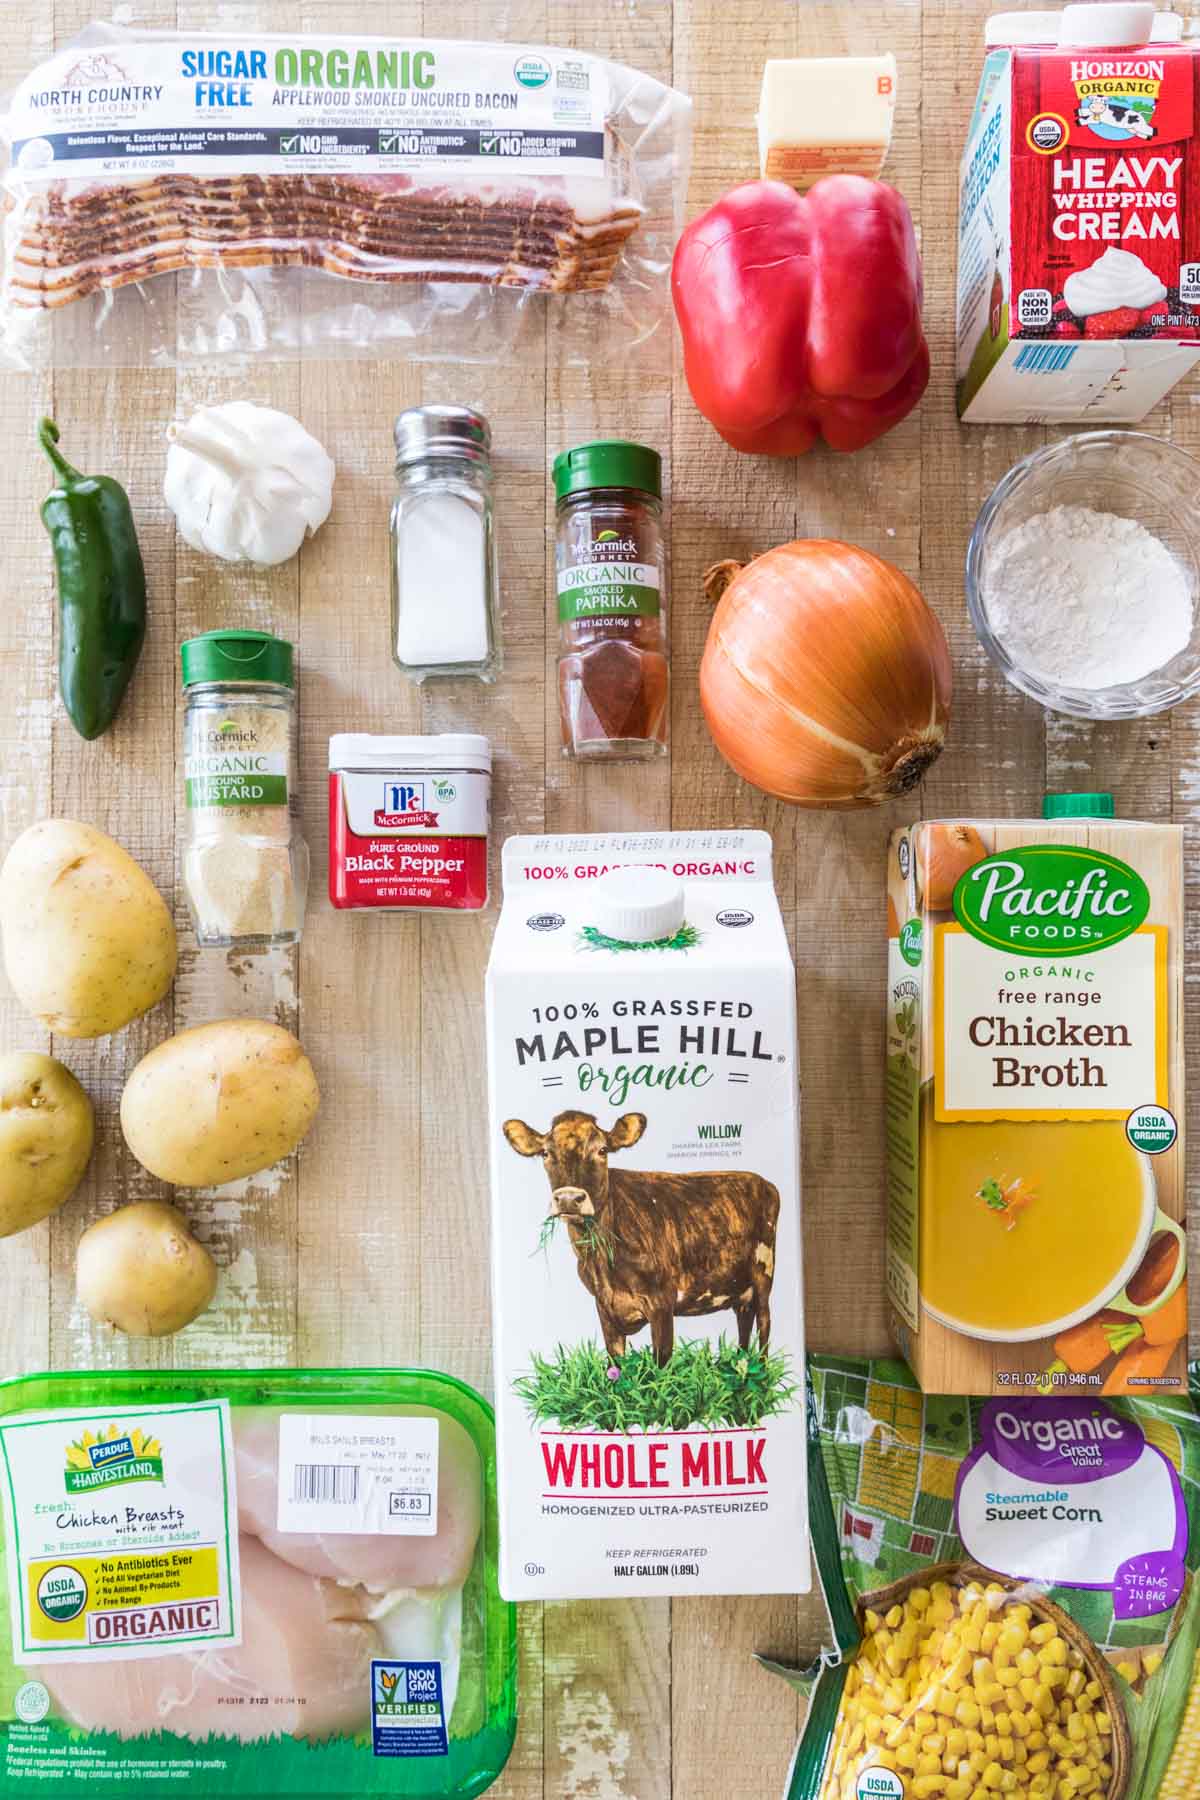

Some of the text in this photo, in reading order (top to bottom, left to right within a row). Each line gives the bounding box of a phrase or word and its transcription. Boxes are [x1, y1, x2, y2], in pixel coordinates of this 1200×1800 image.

[182, 50, 267, 79] SUGAR
[275, 49, 436, 89] ORGANIC
[1070, 60, 1165, 81] HORIZON
[877, 76, 892, 94] B
[1080, 81, 1155, 95] ORGANIC
[30, 90, 82, 109] NORTH
[88, 85, 163, 103] COUNTRY
[195, 82, 253, 107] FREE
[272, 90, 518, 110] APPLEWOOD SMOKED UNCURED BACON
[179, 132, 205, 141] Animal
[207, 132, 225, 141] Care
[227, 132, 267, 141] Standards.
[546, 138, 576, 148] GROWTH
[169, 143, 182, 151] the
[300, 135, 321, 154] NO
[398, 135, 419, 154] NO
[500, 137, 520, 155] NO
[1053, 157, 1183, 190] HEAVY
[1052, 192, 1177, 209] WHIPPING
[1052, 212, 1180, 240] CREAM
[1021, 299, 1048, 307] NON
[1021, 308, 1049, 316] GMO
[1151, 315, 1165, 326] ONE
[1167, 315, 1183, 326] PINT
[571, 540, 638, 554] McCormick
[565, 566, 645, 586] ORGANIC
[584, 586, 623, 595] SMOKED
[576, 595, 637, 611] PAPRIKA
[377, 815, 430, 826] McCormick
[370, 843, 440, 853] PURE GROUND
[345, 855, 465, 876] Black Pepper
[523, 865, 569, 880] 100%
[377, 887, 387, 896] NET
[388, 887, 397, 896] WT
[408, 887, 417, 896] OZ
[971, 861, 1133, 922] Pacific
[1004, 966, 1095, 983] ORGANIC
[998, 988, 1102, 1007] free range
[532, 999, 754, 1023] 100% GRASSFED
[968, 1016, 1132, 1047] Chicken
[515, 1025, 661, 1066] MAPLE
[992, 1057, 1107, 1087] Broth
[577, 1061, 714, 1106] organic
[1137, 1117, 1166, 1128] USDA
[698, 1124, 742, 1140] WILLOW
[1133, 1130, 1170, 1141] ORGANIC
[998, 1373, 1010, 1385] 32
[1051, 1373, 1067, 1386] QT)
[1069, 1373, 1087, 1385] 946
[1088, 1373, 1103, 1385] mL
[995, 1411, 1124, 1451] Organic
[91, 1442, 130, 1459] PERDUE
[1060, 1443, 1101, 1457] Great
[541, 1438, 768, 1488] WHOLE MILK
[1071, 1455, 1103, 1467] Value
[72, 1464, 154, 1488] HARVESTLAND
[393, 1498, 422, 1510] $6.83
[985, 1491, 1069, 1505] Steamable
[33, 1501, 76, 1514] fresh:
[541, 1501, 768, 1516] HOMOGENIZED ULTRA-PASTEURIZED
[985, 1507, 1103, 1522] Sweet Corn
[56, 1504, 185, 1529] Chicken Breasts
[116, 1525, 137, 1534] with
[161, 1521, 184, 1531] meat
[605, 1548, 708, 1558] KEEP REFRIGERATED
[101, 1555, 193, 1572] No Antibiotics Ever
[614, 1564, 700, 1577] HALF GALLON (1.89L)
[102, 1569, 180, 1584] Fed All Vegetarian Diet
[1124, 1574, 1168, 1588] STEAMS
[47, 1578, 75, 1593] USDA
[103, 1581, 180, 1595] No Animal By-Products
[44, 1594, 81, 1609] ORGANIC
[103, 1596, 142, 1606] Free Range
[1129, 1589, 1166, 1601] IN BAG
[95, 1605, 212, 1640] ORGANIC
[408, 1669, 435, 1680] NON
[409, 1680, 437, 1692] GMO
[409, 1691, 437, 1702] Project
[377, 1704, 437, 1714] VERIFIED
[7, 1744, 106, 1756] Boneless and Skinless
[867, 1777, 894, 1792] USDA
